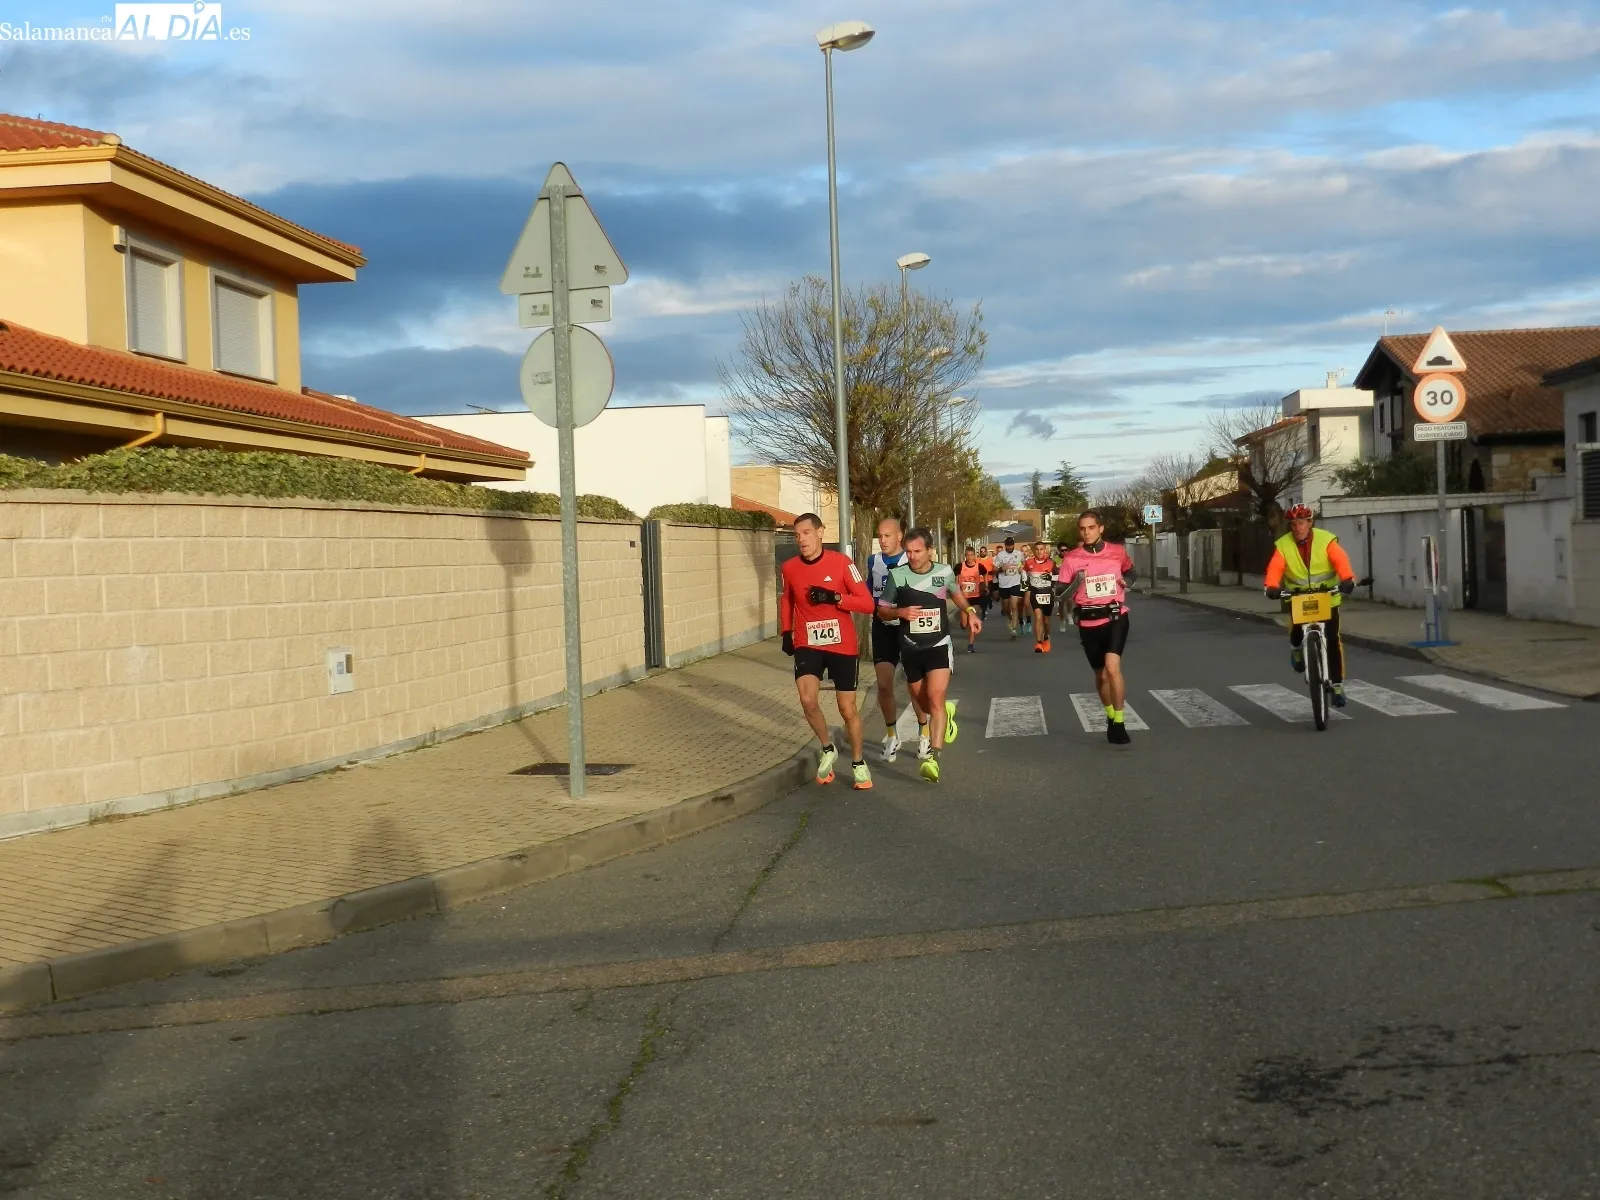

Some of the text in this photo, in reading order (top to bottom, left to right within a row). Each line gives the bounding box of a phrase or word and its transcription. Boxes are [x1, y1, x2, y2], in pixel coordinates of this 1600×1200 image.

[1426, 390, 1453, 406] 30
[1095, 581, 1108, 592] 81
[918, 616, 933, 628] 55
[813, 627, 835, 641] 140
